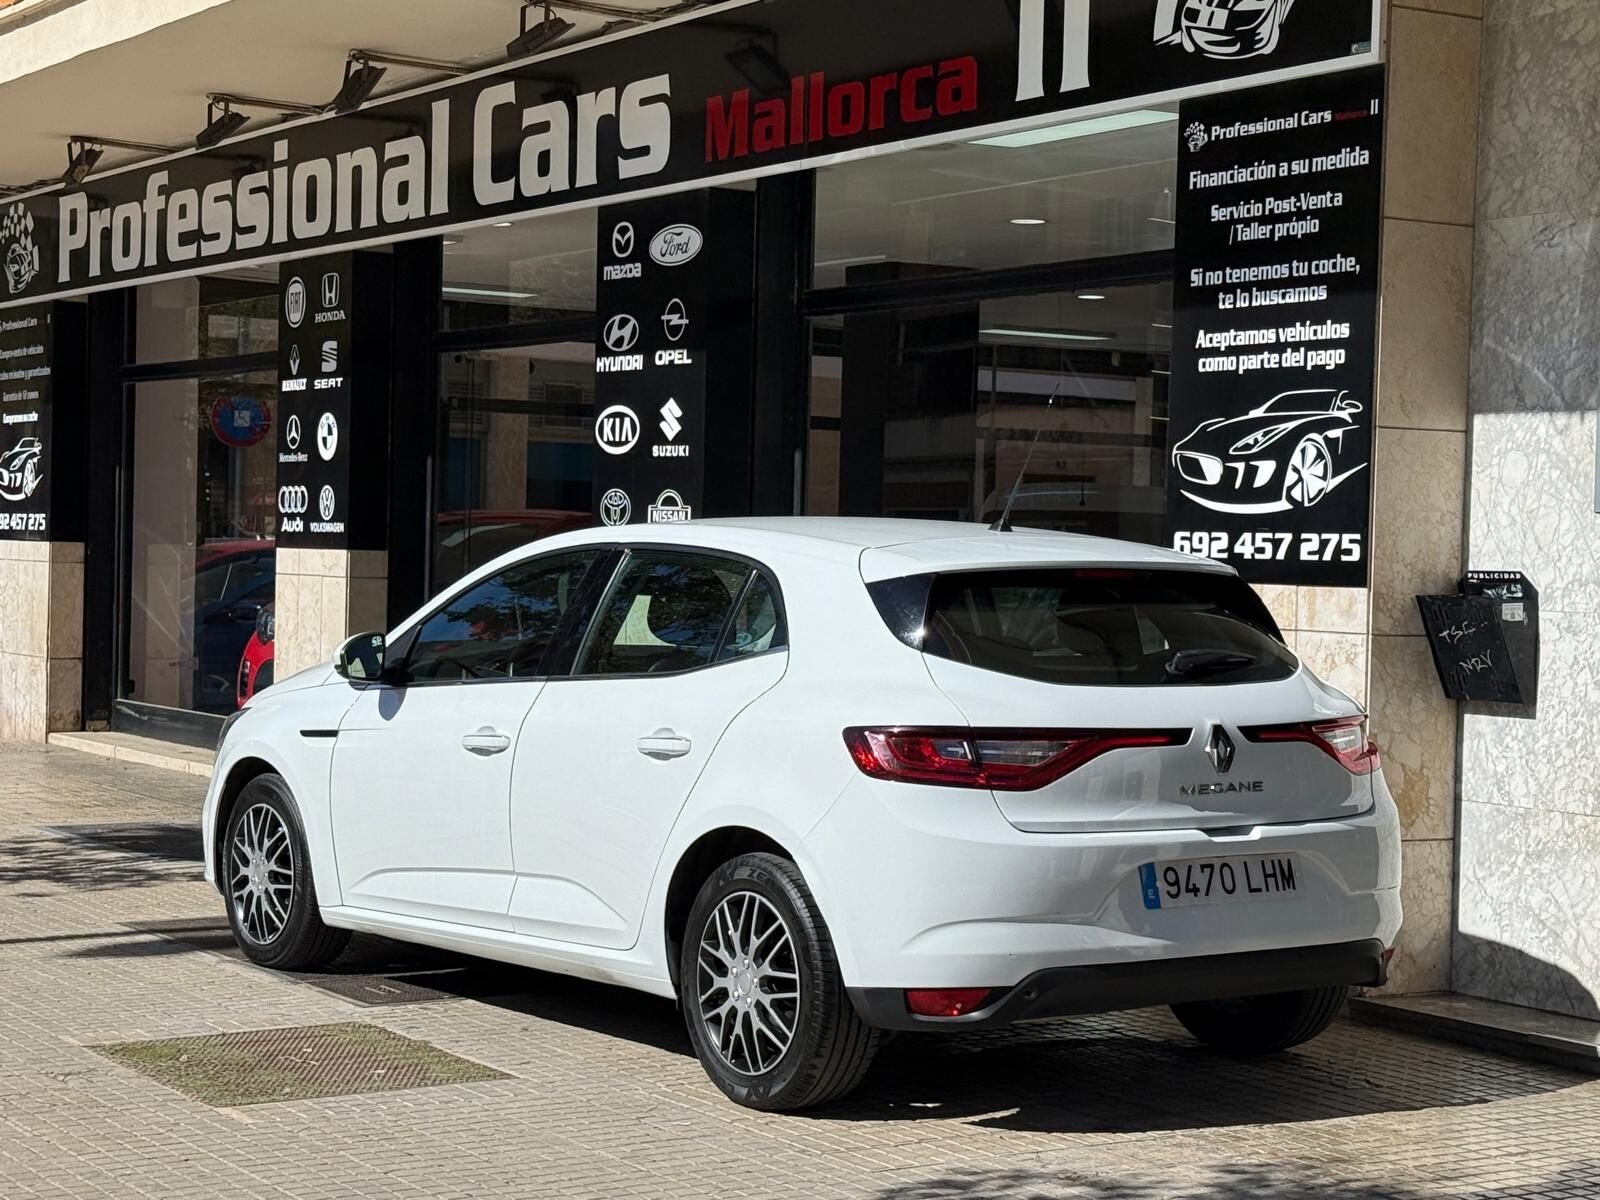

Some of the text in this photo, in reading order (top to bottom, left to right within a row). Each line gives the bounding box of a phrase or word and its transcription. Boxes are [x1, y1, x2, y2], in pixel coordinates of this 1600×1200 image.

[1211, 112, 1298, 141] Professional
[1301, 110, 1332, 127] Cars
[58, 98, 452, 283] Professional
[473, 73, 671, 205] Cars
[704, 55, 978, 162] Mallorca
[1189, 146, 1370, 190] Financiación a su medida
[1210, 191, 1343, 222] Servicio Post-Venta
[1236, 222, 1273, 242] Taller
[1275, 216, 1319, 241] própio
[660, 231, 691, 258] Ford
[603, 262, 642, 281] mazda
[1190, 253, 1360, 287] Si no tenemos tu coche,
[1218, 285, 1327, 310] te lo buscamos
[314, 310, 346, 323] HONDA
[1195, 319, 1350, 351] Aceptamos vehículos
[596, 354, 643, 373] HYUNDAI
[655, 349, 693, 366] OPEL
[1198, 347, 1345, 374] como parte del pago
[314, 377, 343, 390] SEAT
[603, 416, 633, 442] KIA
[652, 445, 690, 457] SUZUKI
[10, 513, 27, 530] 457
[28, 513, 46, 530] 275
[281, 516, 304, 532] Audi
[310, 522, 345, 533] VOLKSWAGEN
[652, 510, 686, 523] NISSAN
[1173, 531, 1361, 562] 692 457 275
[1179, 781, 1264, 796] MEGANE
[1162, 859, 1296, 899] 9470 LHM
